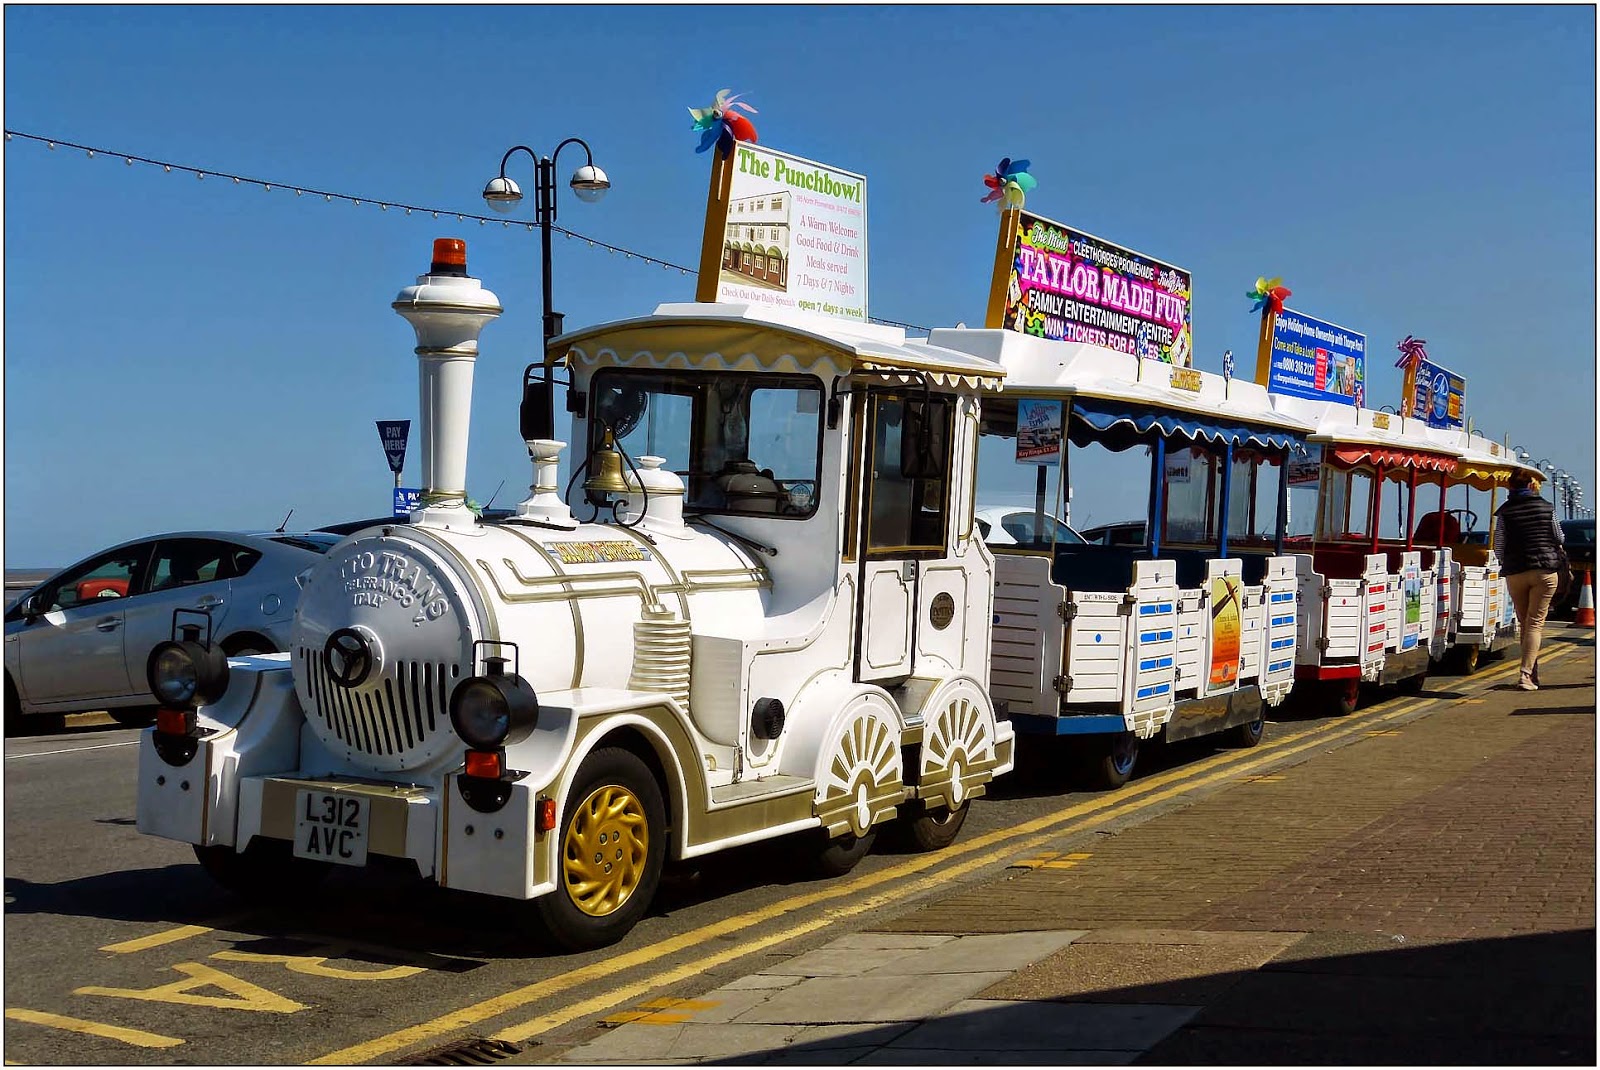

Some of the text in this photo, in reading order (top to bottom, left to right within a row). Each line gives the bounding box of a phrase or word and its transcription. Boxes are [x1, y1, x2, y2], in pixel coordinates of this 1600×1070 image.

[738, 148, 861, 203] The Punchbowl
[800, 214, 858, 239] A Warm Welcome
[1032, 224, 1068, 251] The Mint
[796, 234, 860, 258] Good Food & Drink
[806, 254, 848, 274] Meals served
[1119, 256, 1155, 281] PROMENADE
[722, 286, 738, 298] Check
[740, 290, 750, 299] Out
[750, 292, 761, 301] Our
[796, 274, 855, 296] 7 Days & 7 Nights
[1020, 247, 1100, 300] TAYLOR
[1102, 274, 1154, 315] MADE
[1156, 290, 1186, 325] FUN
[798, 300, 816, 312] open
[817, 302, 822, 312] 7
[823, 302, 838, 315] days
[846, 308, 864, 318] week
[1028, 289, 1063, 316] FAMILY
[1064, 300, 1140, 336] ENTERTAINMENT
[1044, 316, 1159, 360] WIN TICKETS FOR PES
[1276, 314, 1287, 332] Enjoy
[1288, 318, 1303, 338] Holiday
[1304, 323, 1315, 338] Home
[1316, 326, 1334, 346] Ownership
[1335, 332, 1343, 346] with
[1274, 336, 1286, 350] Come
[1292, 342, 1302, 355] Take
[386, 426, 401, 438] PAY
[384, 439, 405, 451] HERE
[382, 551, 450, 622] TRANS
[306, 793, 360, 828] L312
[306, 826, 354, 858] AVC
